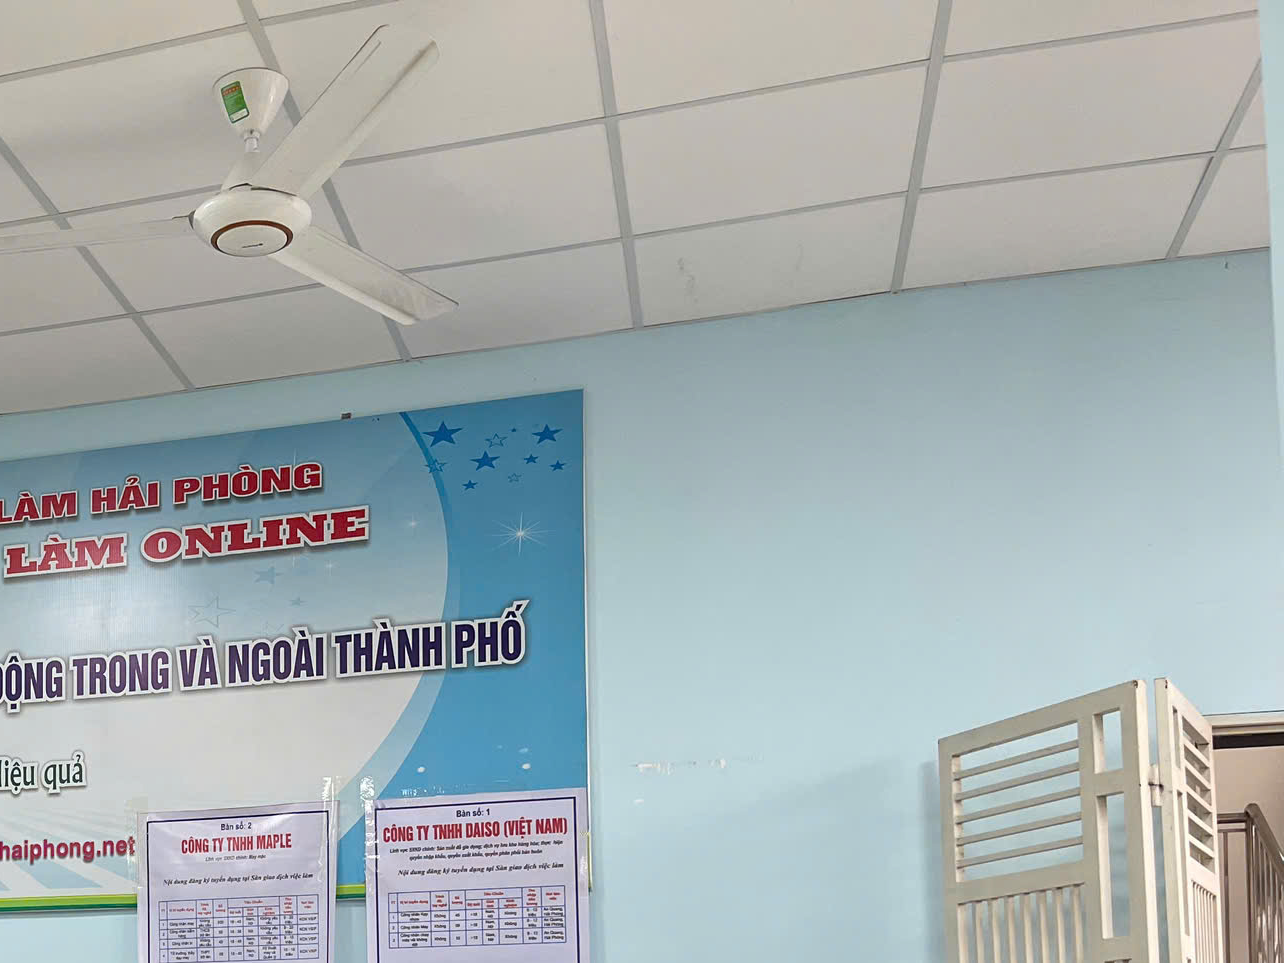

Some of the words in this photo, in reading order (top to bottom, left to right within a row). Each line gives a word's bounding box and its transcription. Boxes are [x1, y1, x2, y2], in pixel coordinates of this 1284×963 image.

[91, 476, 160, 514] HẢI
[173, 462, 322, 504] PHÒNG
[4, 533, 127, 578] LÀM
[141, 505, 369, 562] ONLINE
[70, 648, 172, 700] TRONG
[176, 635, 222, 691] VÀ
[225, 627, 327, 688] NGOÀI
[331, 618, 446, 678] THÀNH
[452, 600, 530, 668] PHỐ
[42, 752, 85, 792] quả
[221, 823, 234, 831] Bàn
[235, 821, 247, 830] số:
[456, 809, 471, 818] Bàn
[473, 807, 484, 817] số:
[181, 836, 209, 854] CÔNG
[212, 838, 225, 853] TY
[227, 836, 254, 852] TNHH
[256, 833, 292, 850] MAPLE
[383, 824, 414, 843] CÔNG
[416, 825, 430, 841] TY
[433, 824, 463, 840] TNHH
[465, 820, 501, 838] DAISO
[504, 817, 532, 839] (VIỆT
[535, 818, 567, 835] NAM)
